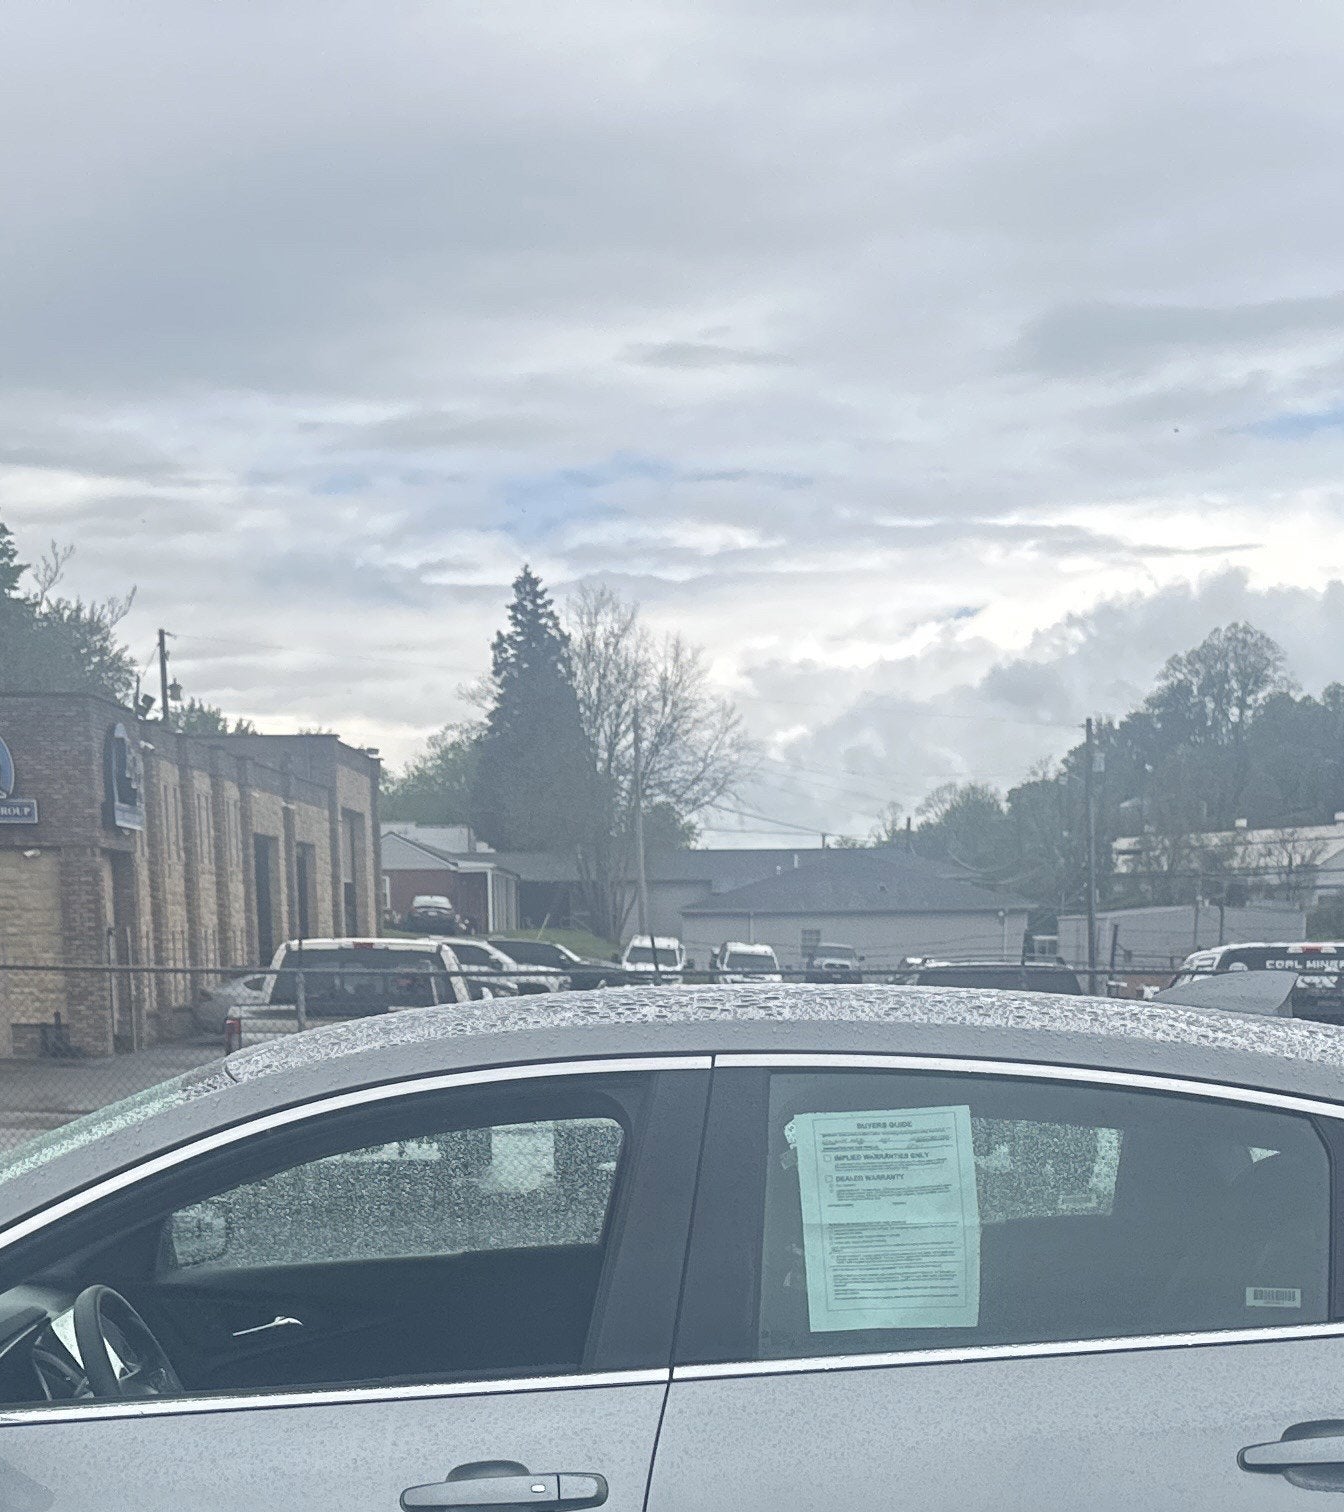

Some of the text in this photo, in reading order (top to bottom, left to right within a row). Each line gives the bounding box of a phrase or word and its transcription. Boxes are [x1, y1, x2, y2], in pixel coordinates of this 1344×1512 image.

[1266, 959, 1302, 969] COAL
[856, 1120, 913, 1130] BUYERS GUIDE
